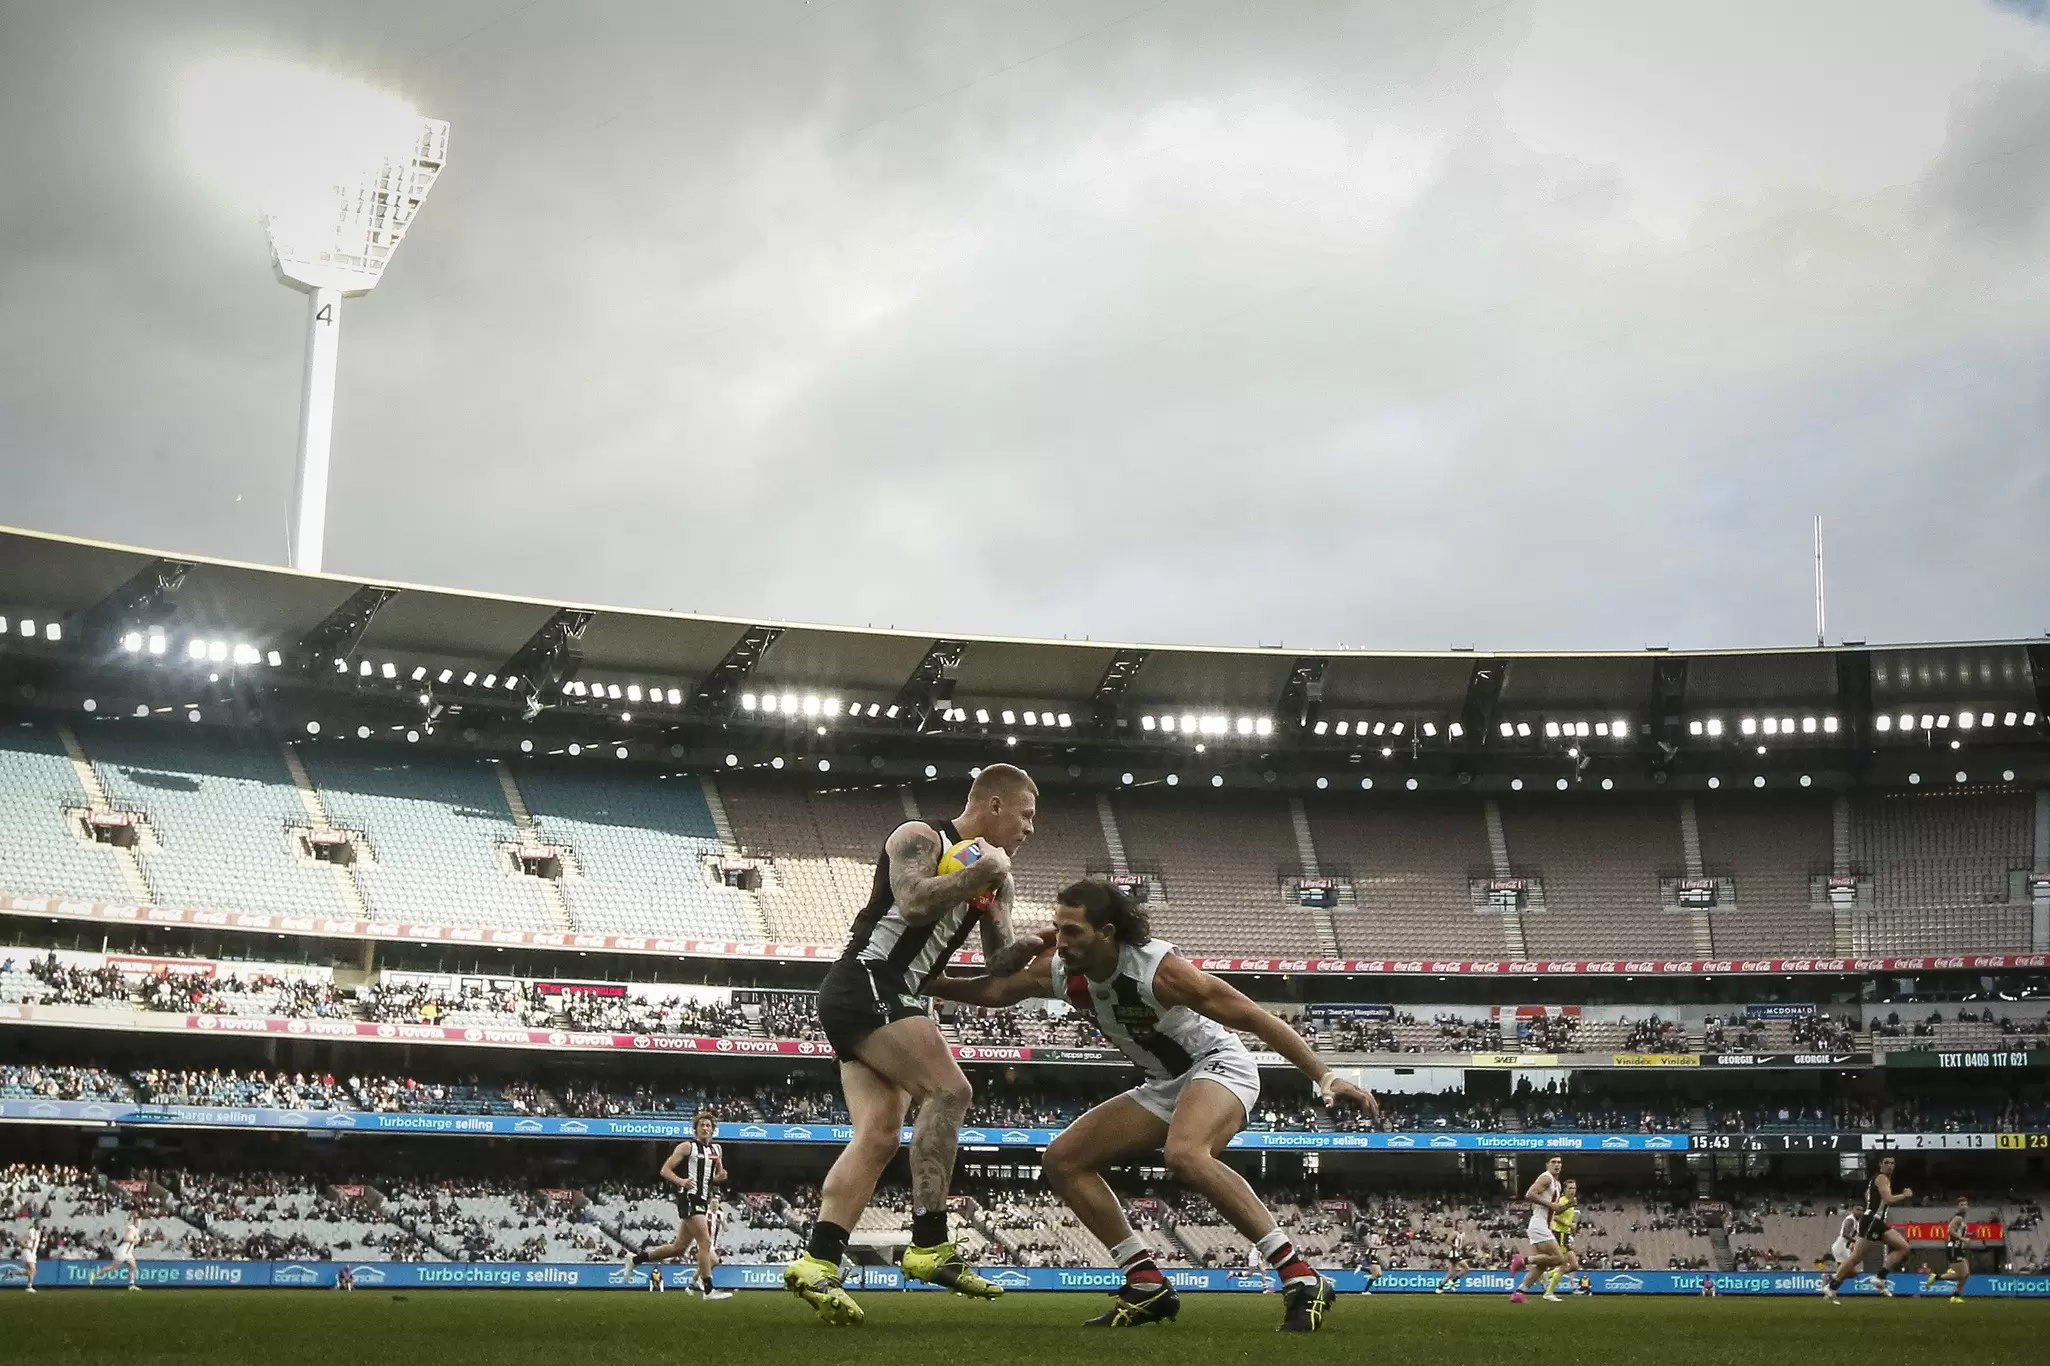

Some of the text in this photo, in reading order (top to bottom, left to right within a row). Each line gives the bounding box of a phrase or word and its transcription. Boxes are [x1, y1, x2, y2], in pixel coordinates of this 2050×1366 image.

[316, 303, 333, 326] 4
[309, 1022, 357, 1034] TOYOTA
[398, 1027, 445, 1039] TOYOTA
[485, 1030, 529, 1043] TOYOTA
[569, 1033, 613, 1046] TOYOTA
[653, 1037, 697, 1049] TOYOTA
[735, 1040, 779, 1052] TOYOTA
[978, 1047, 1021, 1058] TOYOTA
[1718, 1055, 1753, 1065] GEORGIE
[1794, 1055, 1830, 1064] GEORGIE
[1938, 1052, 2028, 1067] TEXT 0409 117 621
[377, 1115, 493, 1131] Turbocharge selling
[609, 1123, 681, 1136] Turbocharge
[1262, 1134, 1368, 1147] Turbocharge selling
[1476, 1137, 1583, 1149] Turbocharge selling
[1692, 1136, 1729, 1148] 15:43
[186, 1265, 241, 1282] selling
[417, 1267, 578, 1285] Turbocharge selling
[1169, 1272, 1209, 1288] elling
[1465, 1272, 1514, 1290] selling
